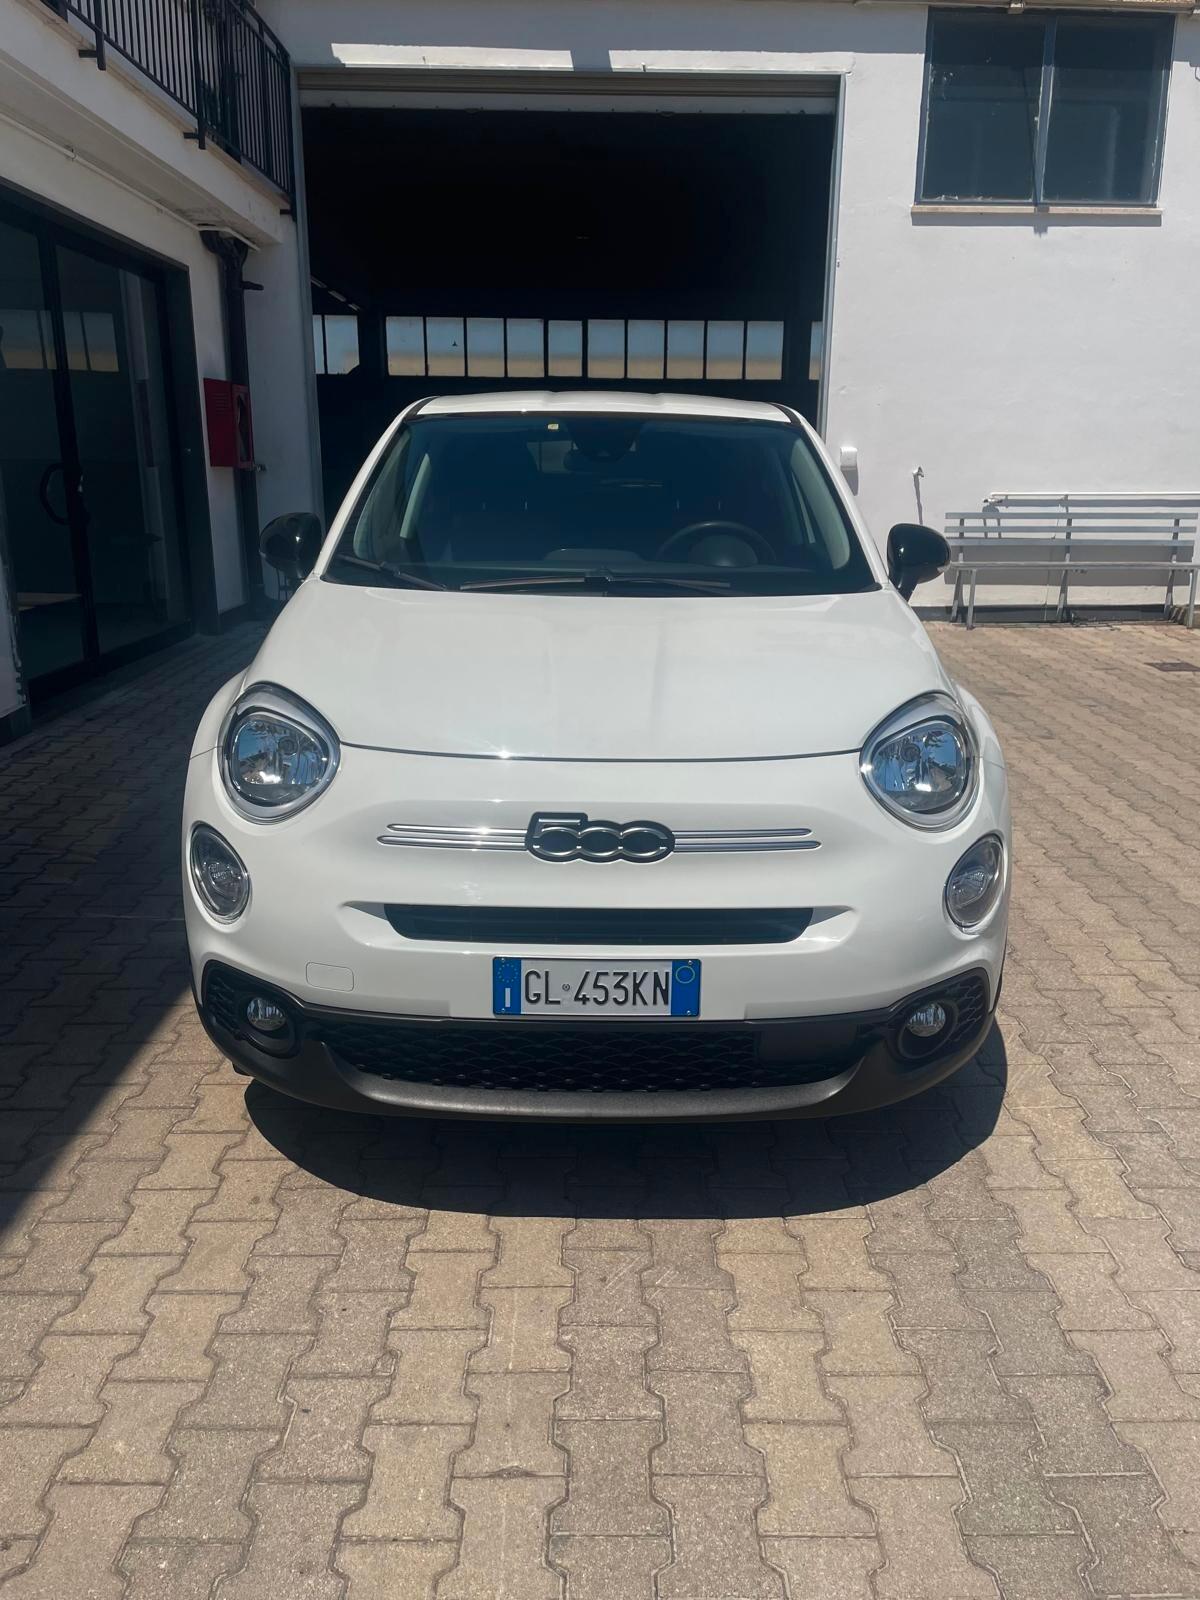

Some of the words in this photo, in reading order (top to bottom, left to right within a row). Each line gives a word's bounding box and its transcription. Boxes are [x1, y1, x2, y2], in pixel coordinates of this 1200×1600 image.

[525, 811, 675, 863] 500
[505, 987, 511, 1007] I
[524, 970, 561, 1005] GL
[573, 971, 669, 1006] 453KN
